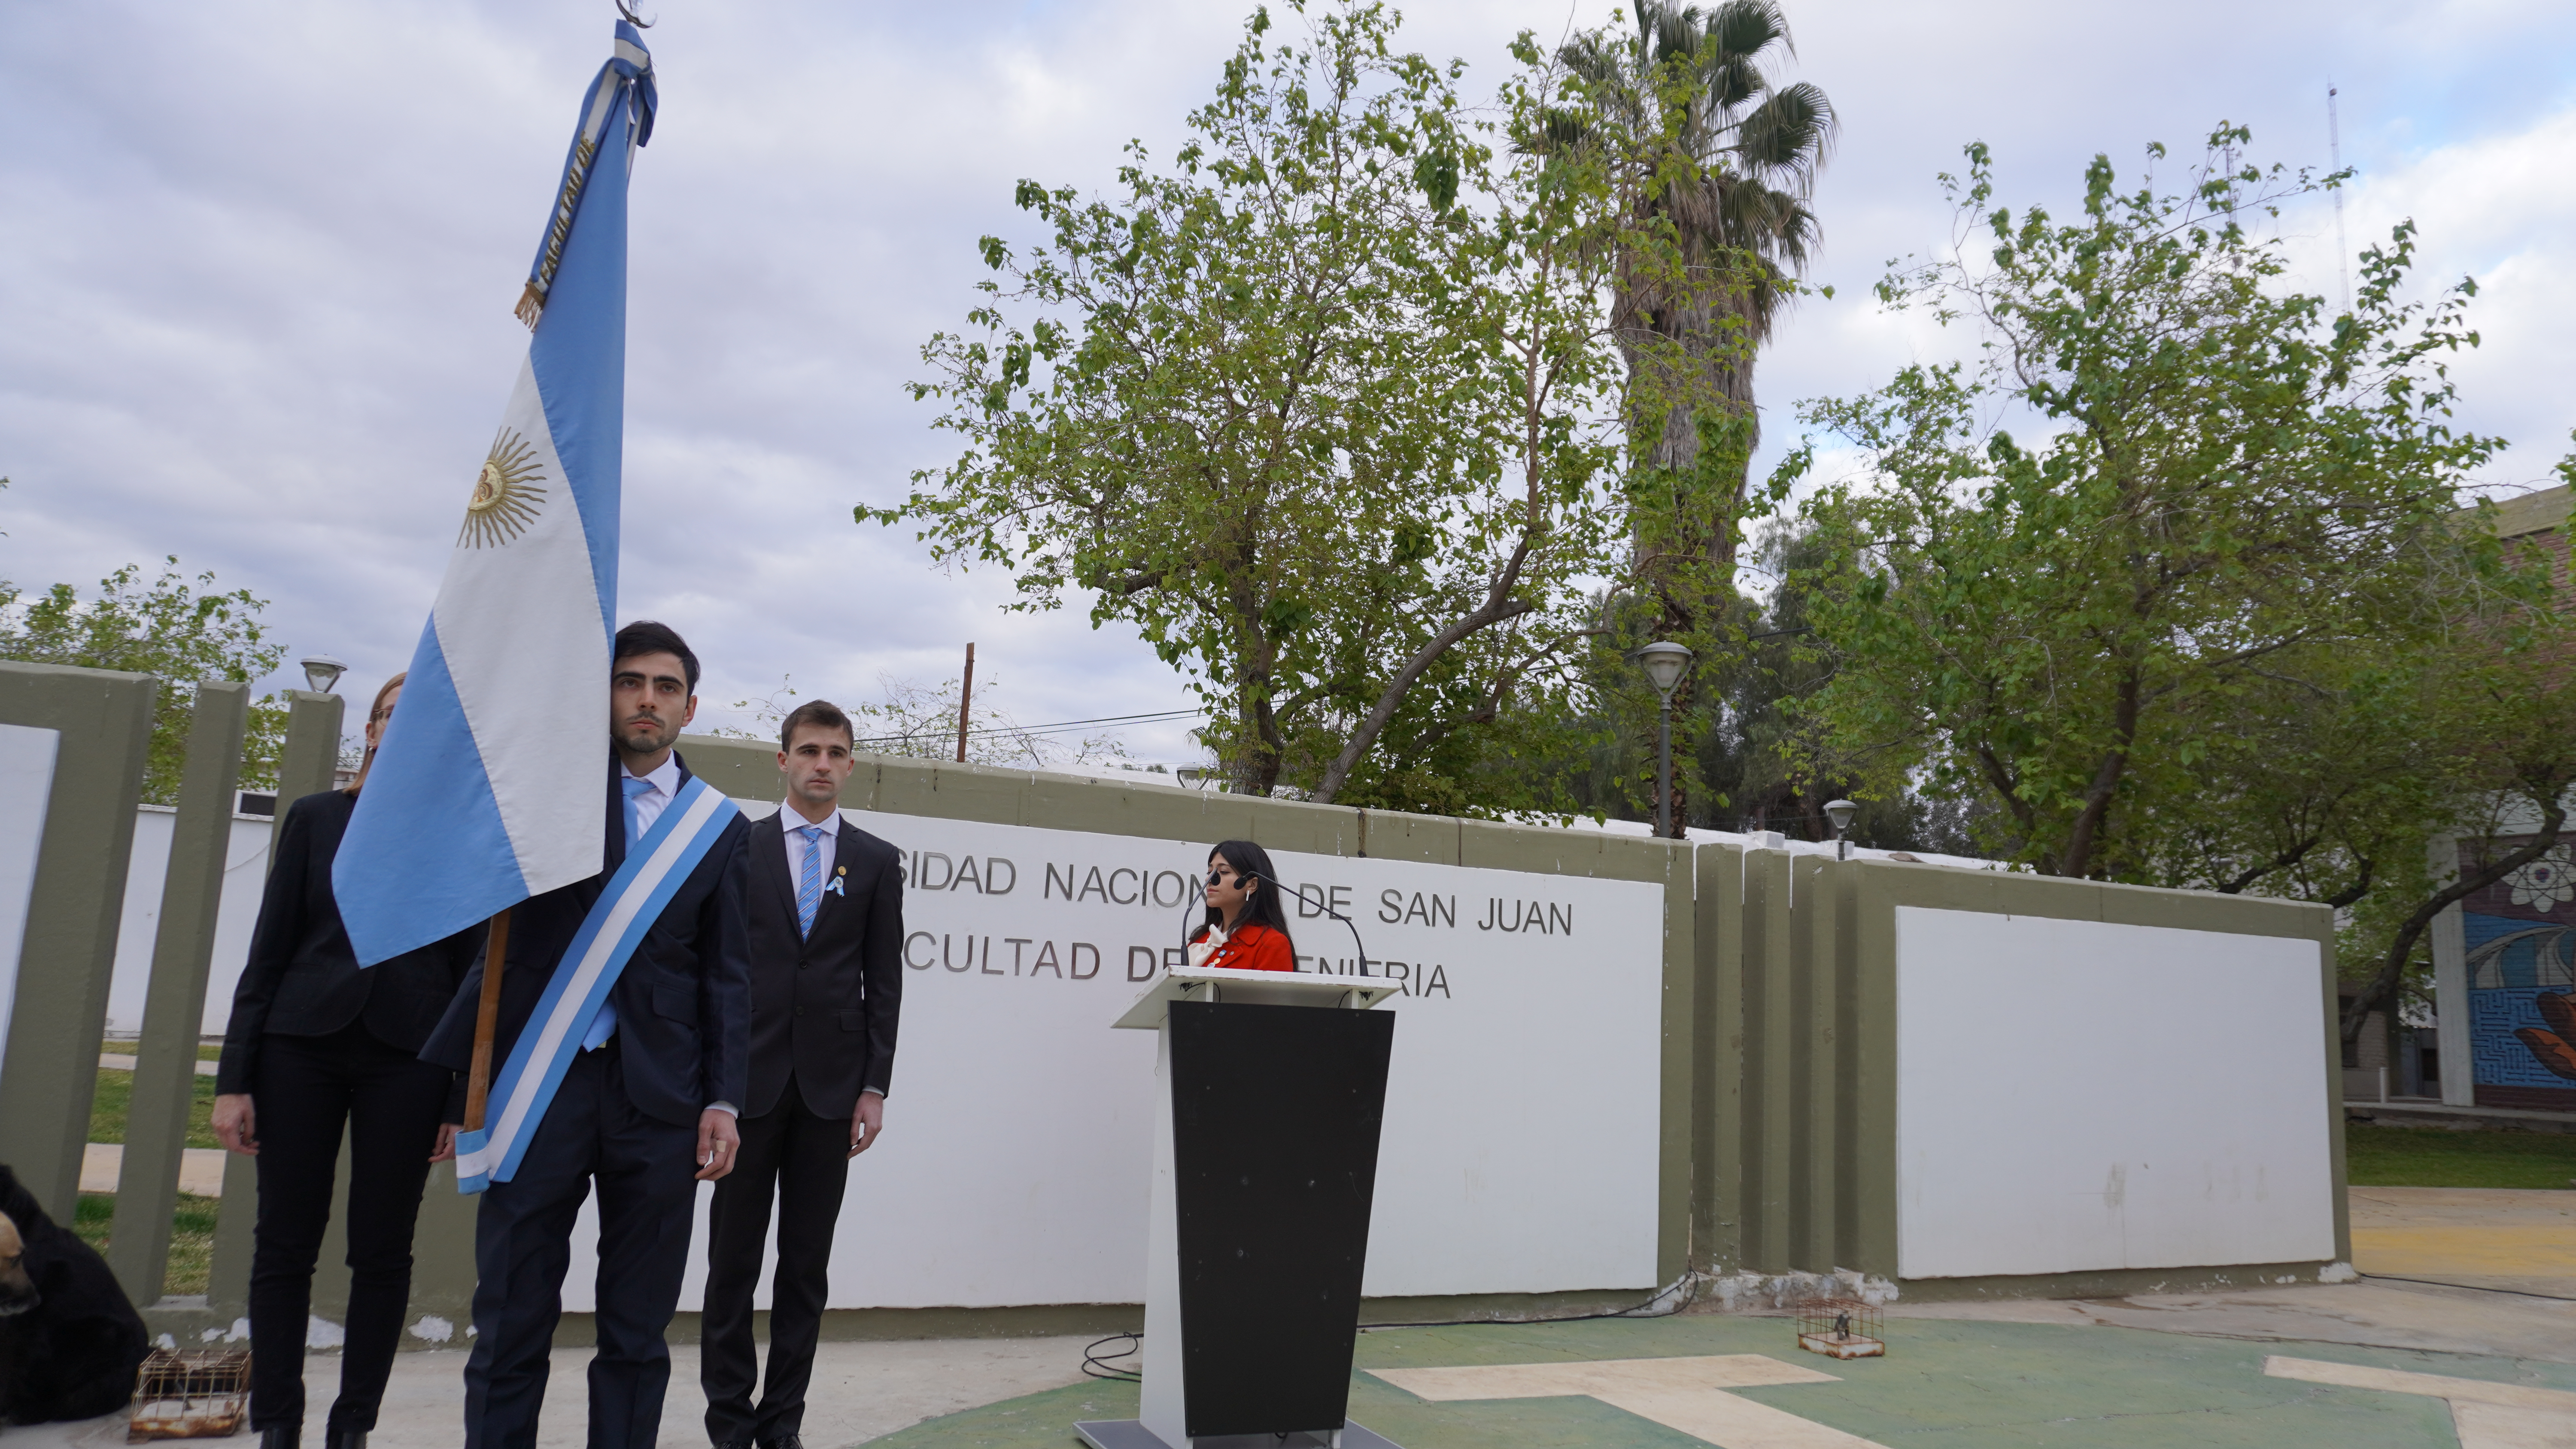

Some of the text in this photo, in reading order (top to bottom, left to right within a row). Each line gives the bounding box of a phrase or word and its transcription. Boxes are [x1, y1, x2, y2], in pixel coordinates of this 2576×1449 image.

[540, 130, 595, 286] FACULTAD DE
[1299, 883, 1352, 921] DE
[1379, 889, 1455, 928] SAN
[1477, 898, 1571, 936] JUAN
[904, 931, 1100, 979] CULTAD
